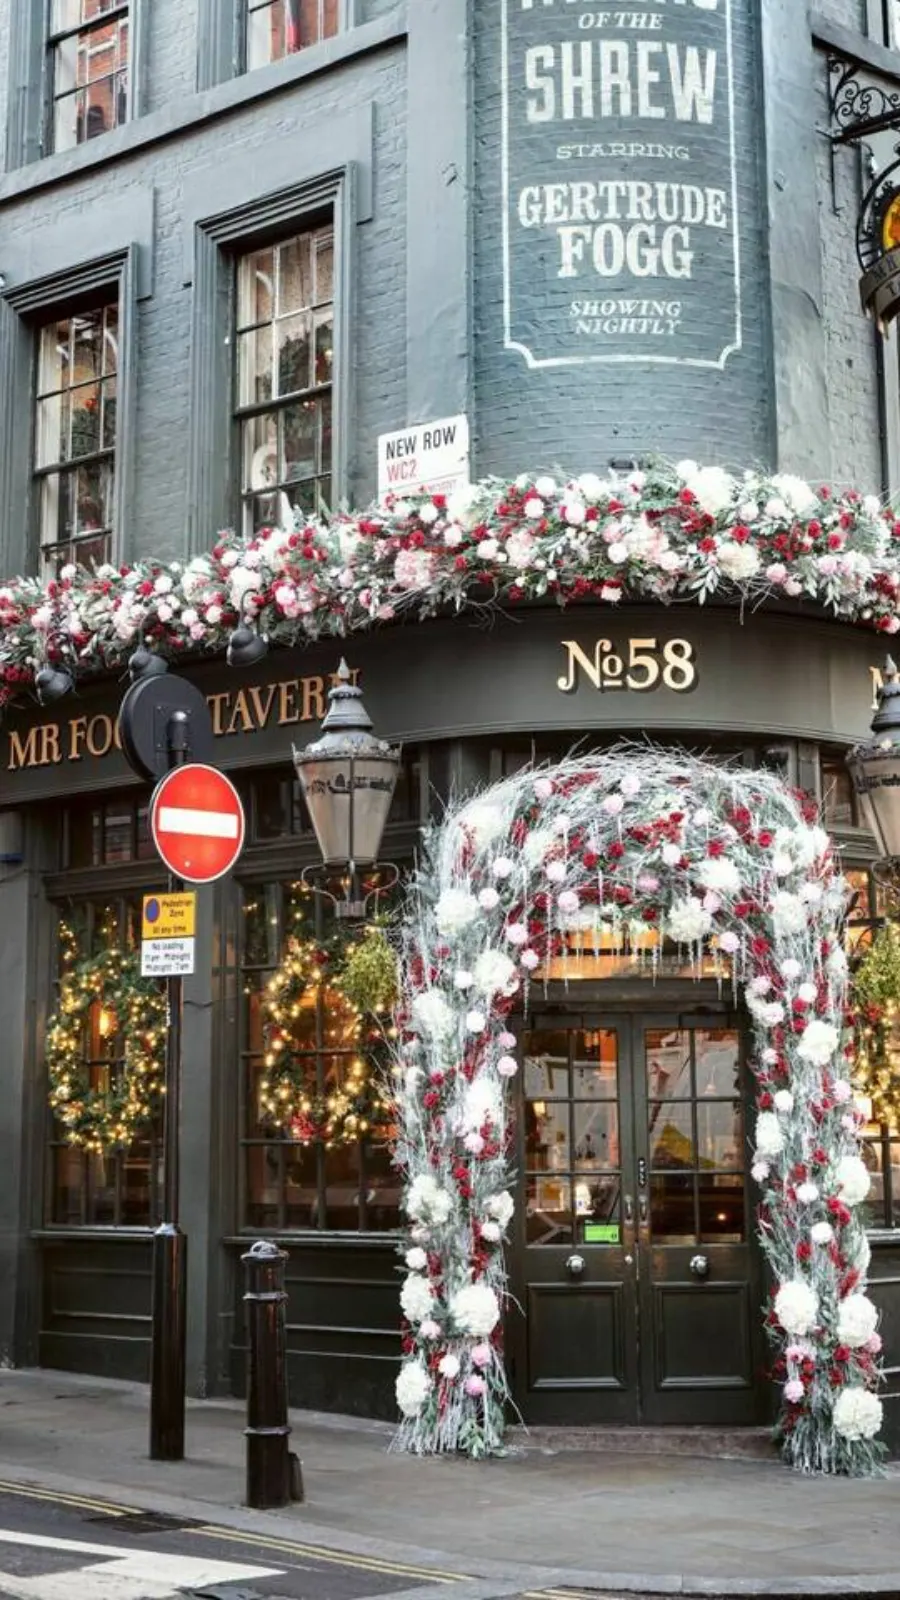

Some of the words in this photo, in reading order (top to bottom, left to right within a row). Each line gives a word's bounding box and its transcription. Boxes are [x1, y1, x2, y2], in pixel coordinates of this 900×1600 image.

[578, 12, 610, 29] OF
[612, 11, 664, 30] THE
[525, 39, 717, 125] SHREW
[556, 142, 691, 161] STARRING
[517, 180, 728, 229] GERTRUDE
[556, 222, 694, 279] FOGG
[569, 299, 682, 317] SHOWING
[575, 318, 682, 335] NIGHTLY
[386, 435, 417, 460] NEW
[423, 425, 456, 451] ROW
[387, 459, 418, 482] WC2
[8, 724, 62, 770] MR
